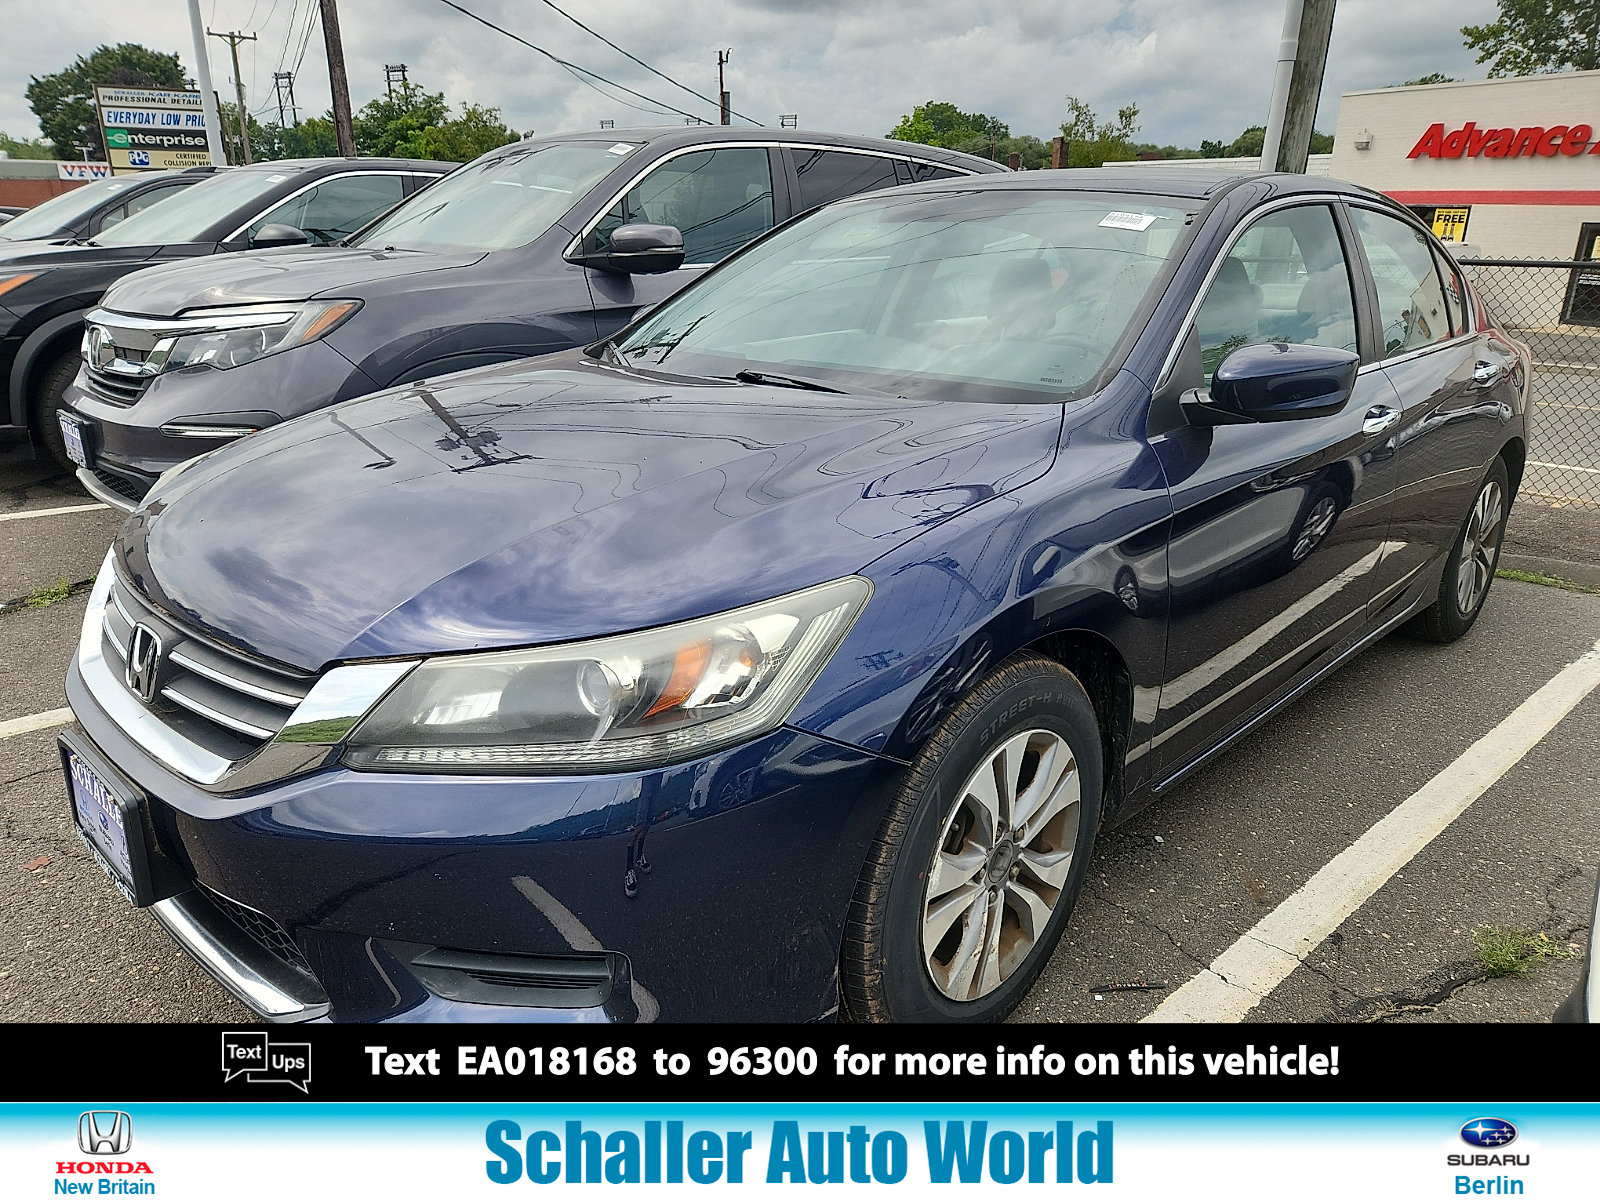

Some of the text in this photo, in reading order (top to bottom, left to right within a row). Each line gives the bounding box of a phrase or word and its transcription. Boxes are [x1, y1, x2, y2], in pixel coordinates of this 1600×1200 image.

[102, 95, 167, 104] PROFESSIONAL
[107, 110, 157, 124] EVERYDAY
[161, 113, 181, 126] LOW
[108, 133, 206, 147] enterprise
[1406, 122, 1593, 158] Advance
[129, 150, 149, 164] PPG
[163, 159, 197, 167] COLLISION
[61, 164, 109, 178] VFW
[1435, 214, 1466, 224] FREE
